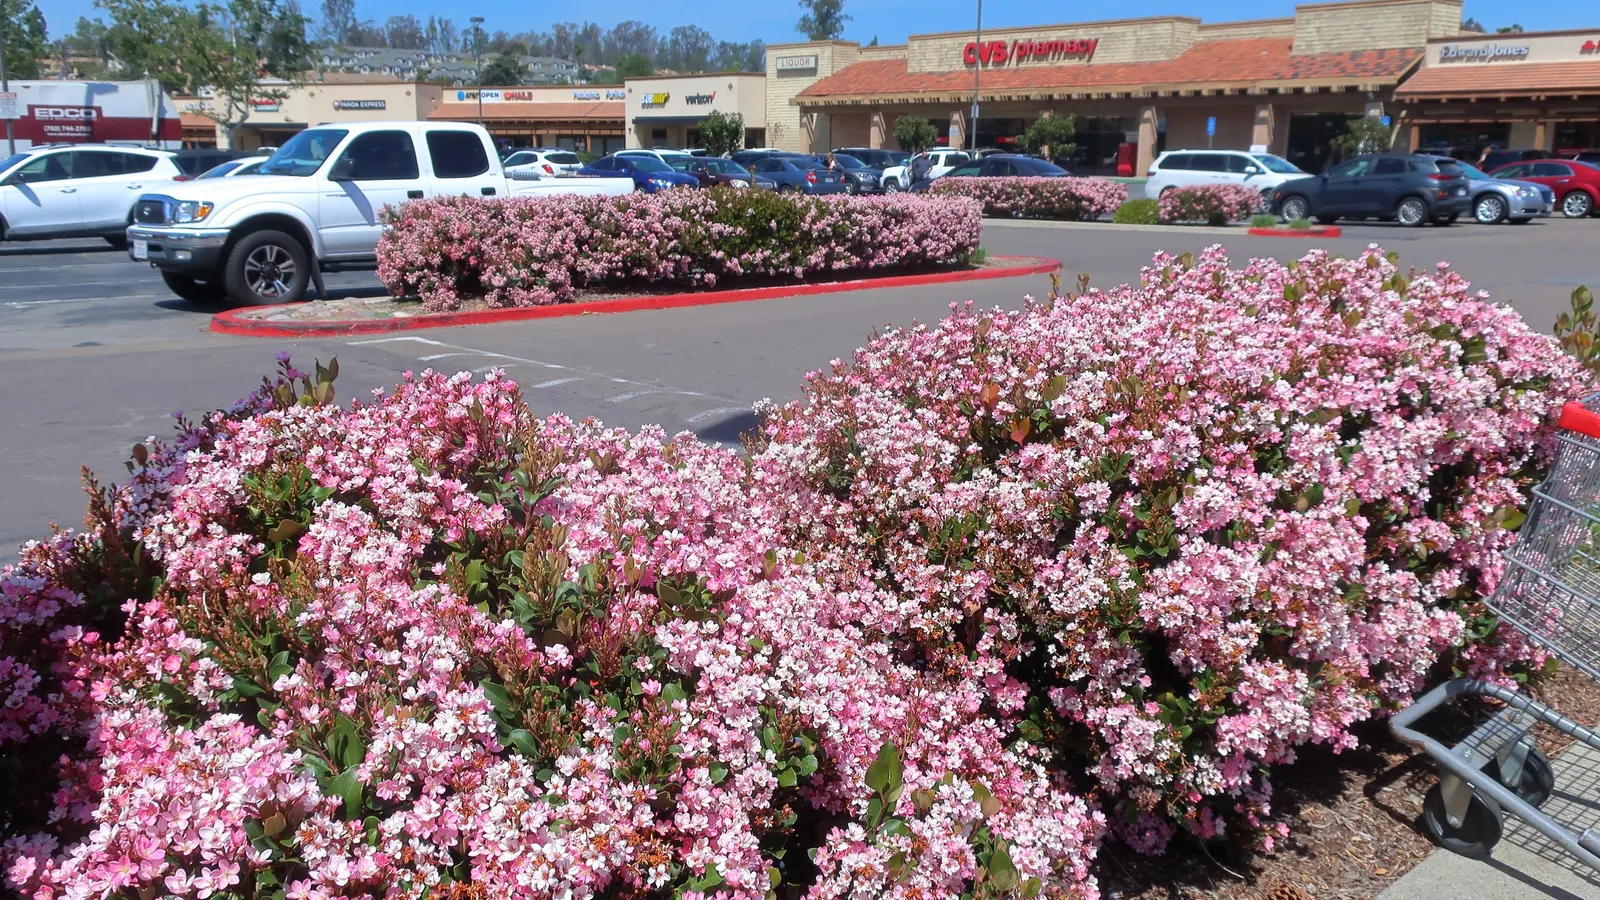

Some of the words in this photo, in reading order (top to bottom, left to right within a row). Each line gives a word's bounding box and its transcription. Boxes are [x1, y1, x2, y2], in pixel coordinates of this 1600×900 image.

[1440, 44, 1487, 57] Edward
[1486, 44, 1528, 58] Jones
[781, 58, 810, 67] LIQUOR
[641, 92, 669, 104] SUBWAY
[685, 93, 713, 105] verizon
[34, 108, 97, 118] EDCO
